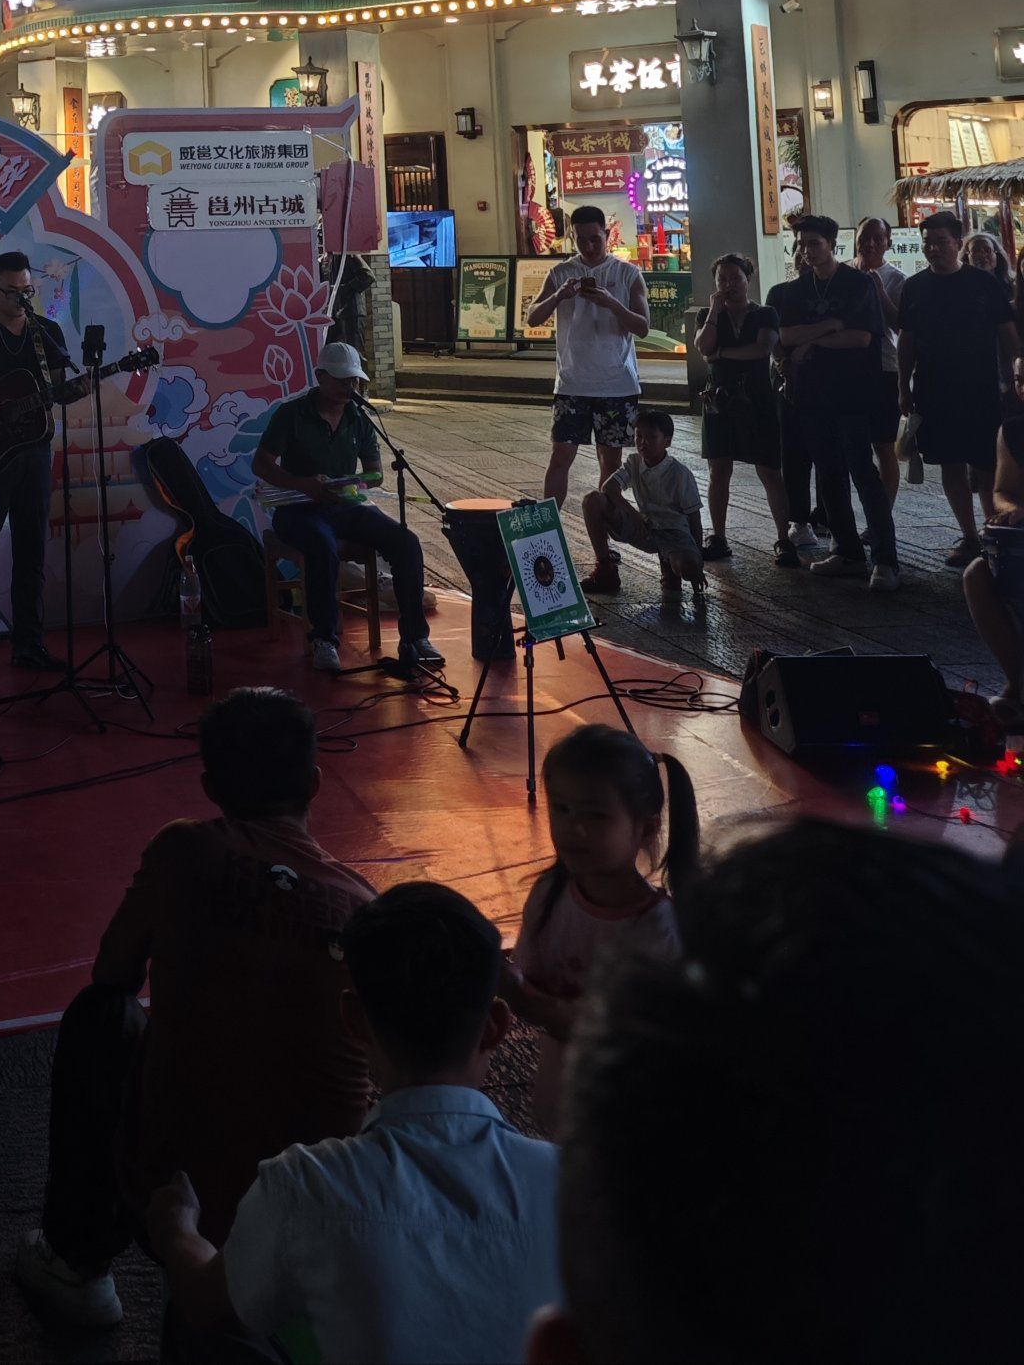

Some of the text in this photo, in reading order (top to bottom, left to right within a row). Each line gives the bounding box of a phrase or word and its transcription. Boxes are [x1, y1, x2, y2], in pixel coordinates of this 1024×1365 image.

[179, 144, 308, 160] 威邕文化旅游集团
[214, 162, 243, 170] CULTURE
[286, 161, 309, 169] GROUP
[208, 194, 305, 216] 邕州古城
